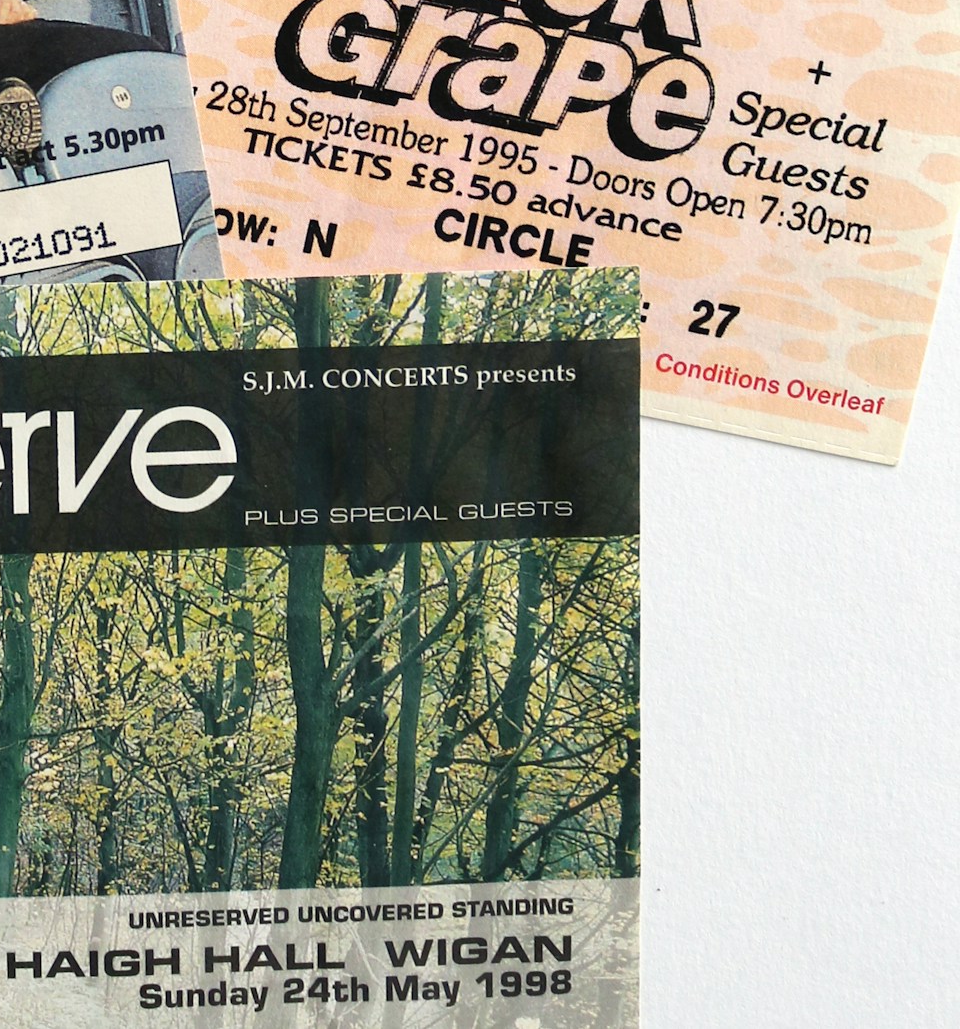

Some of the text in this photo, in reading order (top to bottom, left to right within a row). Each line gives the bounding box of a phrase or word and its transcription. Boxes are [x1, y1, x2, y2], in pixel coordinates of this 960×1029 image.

[63, 123, 165, 157] 5.30pm
[730, 91, 888, 151] Special
[205, 80, 872, 245] 28th September 1995 Doors Open 7:30pm
[243, 127, 683, 242] TICKETS £8.50 advance
[722, 141, 869, 199] Guests
[434, 208, 595, 267] CIRCLE
[688, 300, 740, 337] 27
[243, 364, 576, 395] S.J.M. CONCERTS presents
[656, 354, 884, 415] Conditions Overleaf
[245, 500, 573, 526] PLUS SPECIAL GUESTS
[128, 896, 574, 930] UNRESERVED UNCOVERED STANDING
[5, 935, 573, 979] HAIGH HALL WIGAN
[139, 971, 572, 1010] Sunday 24th May 1998
